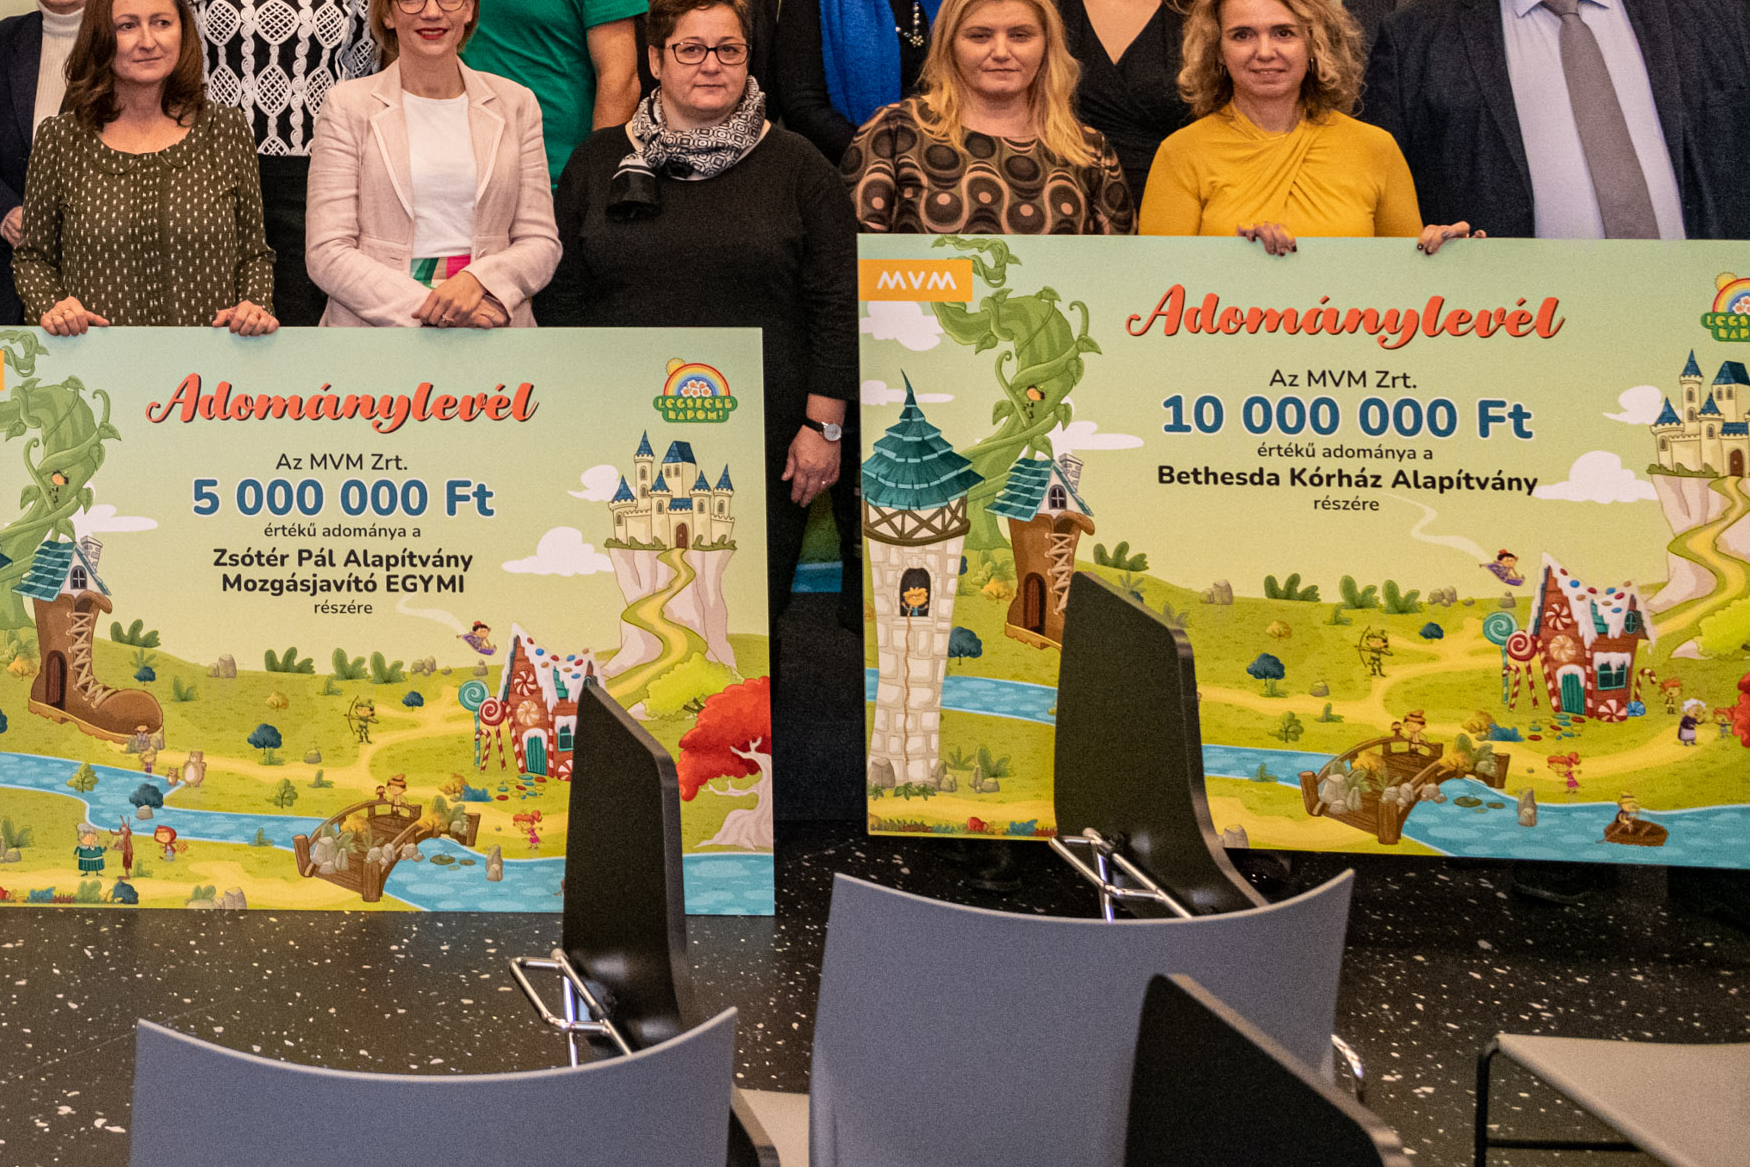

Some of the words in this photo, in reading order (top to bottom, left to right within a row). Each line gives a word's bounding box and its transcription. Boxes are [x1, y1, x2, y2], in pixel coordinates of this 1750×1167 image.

[877, 270, 957, 291] MVM
[1125, 283, 1566, 350] Adománylevél
[1269, 369, 1300, 387] Az
[1307, 369, 1367, 388] MVM
[1375, 370, 1418, 389] Zrt.
[145, 372, 539, 434] Adománylevél
[1163, 395, 1225, 435] 10
[1243, 396, 1341, 437] 000
[1359, 397, 1458, 438] 000
[1478, 400, 1534, 439] Ft
[275, 453, 303, 470] Az
[310, 453, 363, 470] MVM
[371, 453, 408, 471] Zrt.
[1257, 442, 1316, 459] értékű
[1322, 443, 1418, 463] adománya
[1422, 449, 1433, 460] a
[1158, 465, 1280, 486] Bethesda
[1290, 466, 1383, 489] Kórház
[1391, 469, 1539, 496] Alapítvány
[193, 479, 220, 515] 5
[236, 479, 324, 516] 000
[340, 479, 428, 516] 000
[446, 480, 495, 517] Ft
[1313, 495, 1380, 512] részére
[264, 522, 317, 537] értékű
[322, 522, 407, 541] adománya
[412, 527, 421, 538] a
[213, 546, 290, 567] Zsótér
[297, 547, 337, 568] Pál
[343, 547, 473, 572] Alapítvány
[222, 572, 378, 596] Mozgásjavító
[386, 574, 464, 593] EGYMI
[314, 599, 373, 615] részére
